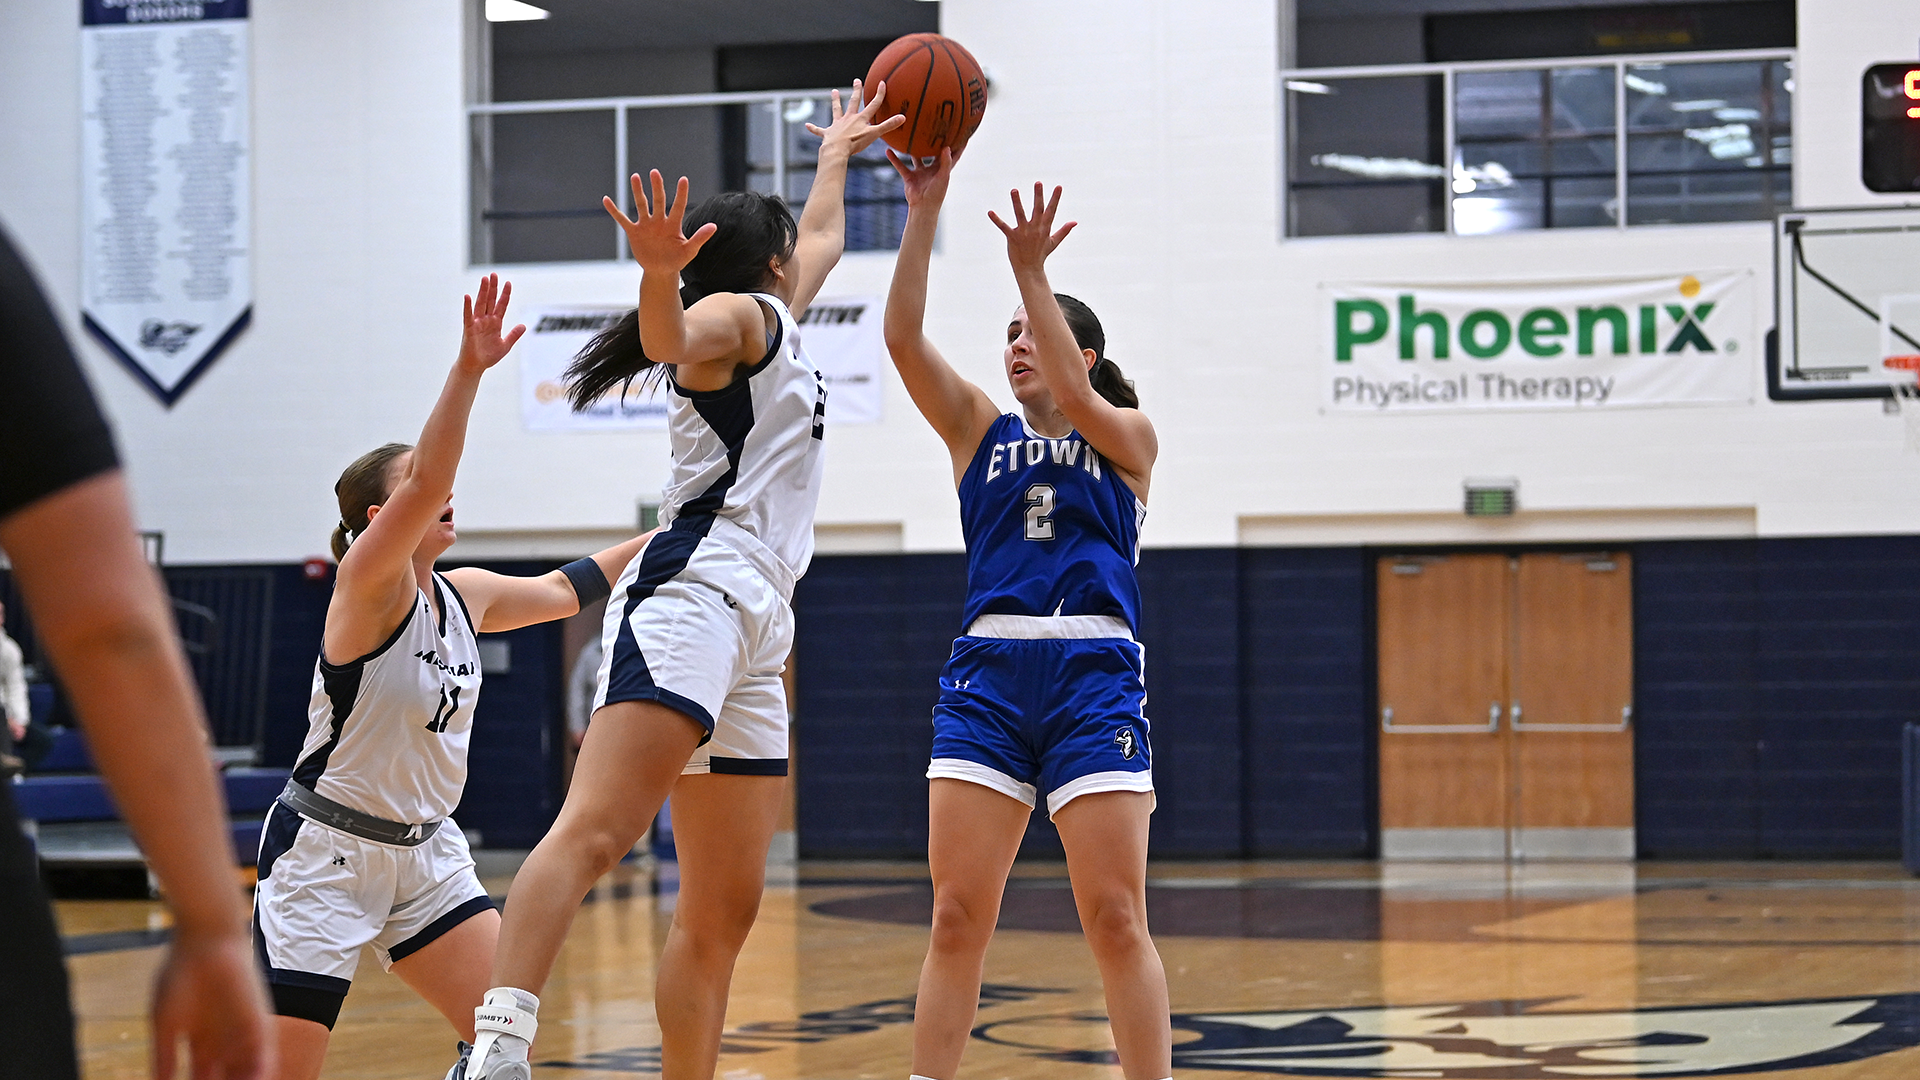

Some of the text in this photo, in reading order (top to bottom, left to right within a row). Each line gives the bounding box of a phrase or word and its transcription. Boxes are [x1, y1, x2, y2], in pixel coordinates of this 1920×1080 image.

[1334, 293, 1717, 362] Phoenix
[1333, 372, 1615, 408] Physical Therapy
[986, 438, 1102, 486] ETOWN
[1024, 483, 1057, 541] 2
[425, 682, 461, 733] 11
